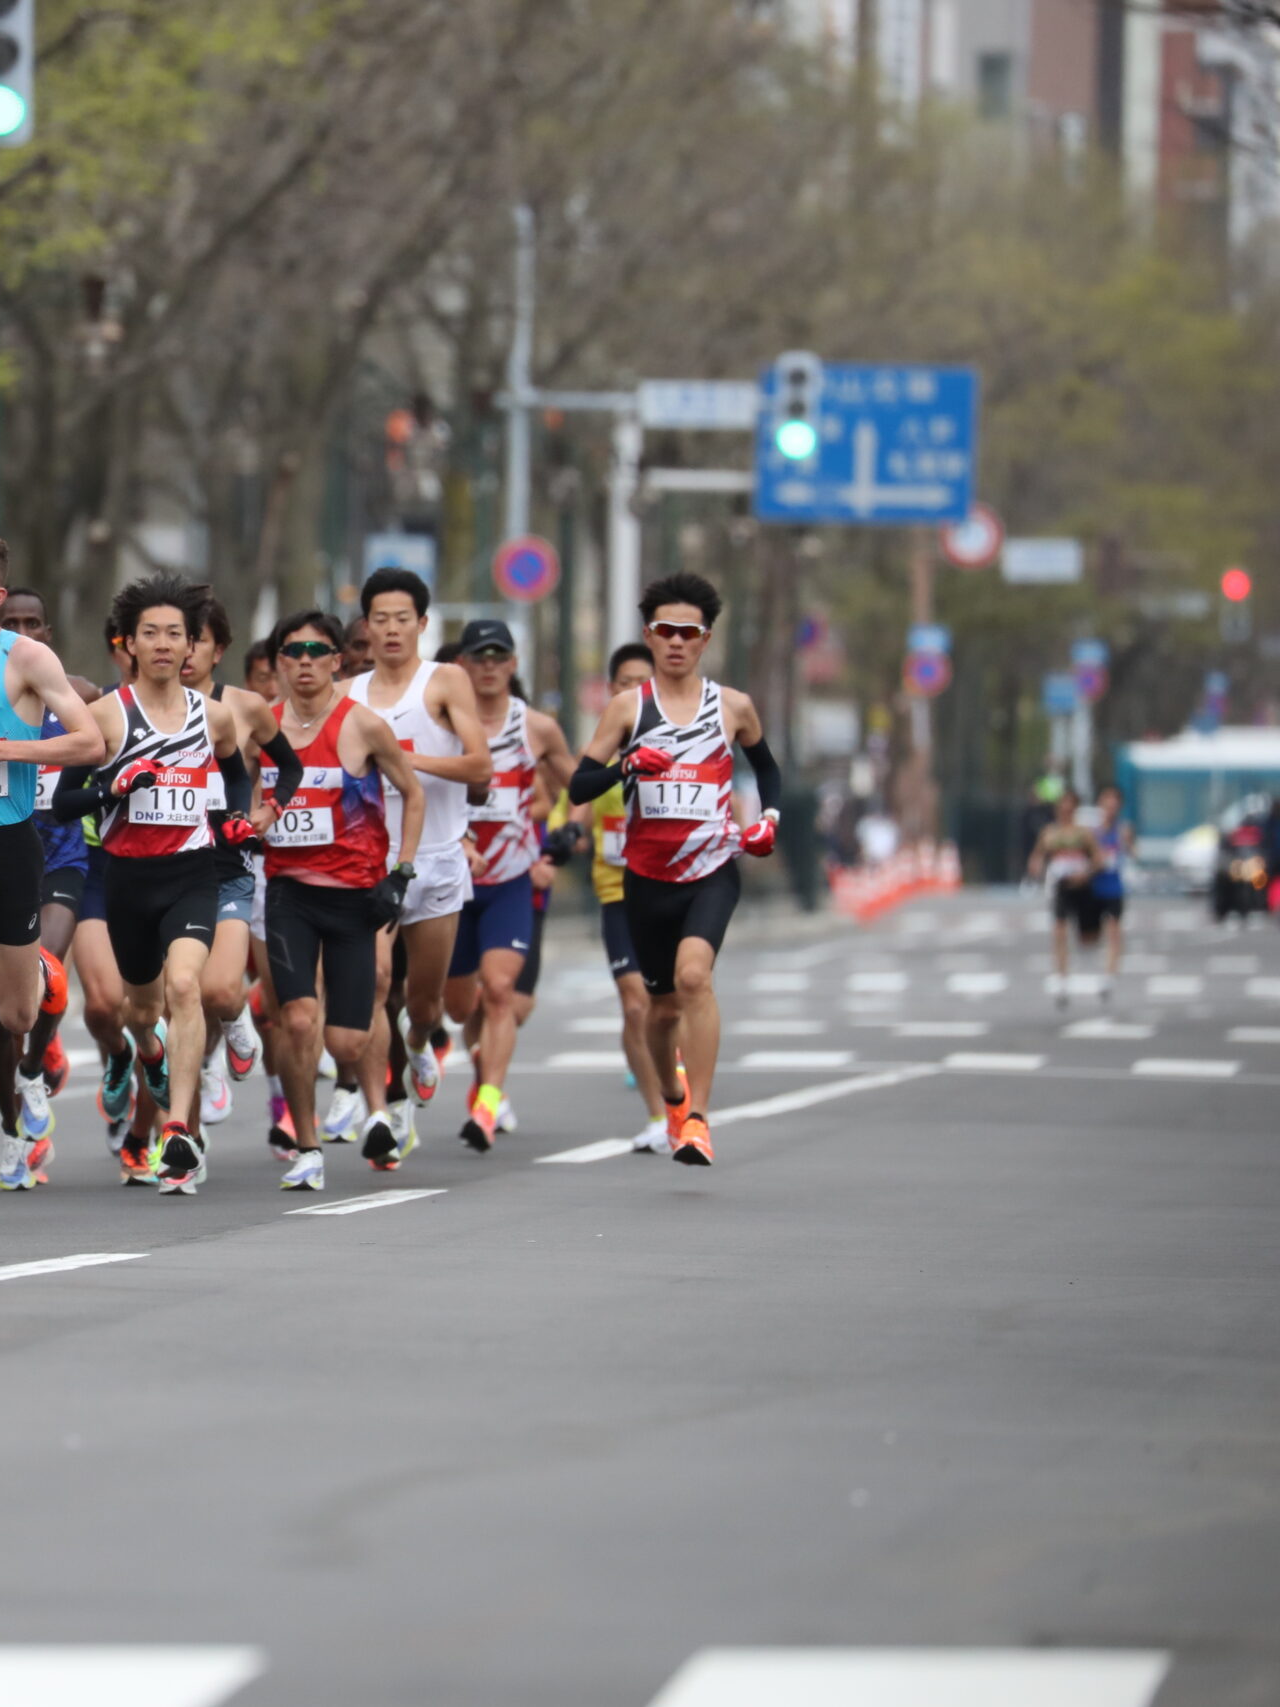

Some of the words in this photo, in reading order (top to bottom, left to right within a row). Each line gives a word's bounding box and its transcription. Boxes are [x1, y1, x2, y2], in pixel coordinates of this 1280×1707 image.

[176, 751, 206, 759] TOYOTA
[150, 787, 196, 812] 110
[656, 783, 703, 805] 117
[135, 811, 164, 822] DNP
[645, 806, 670, 816] DNP
